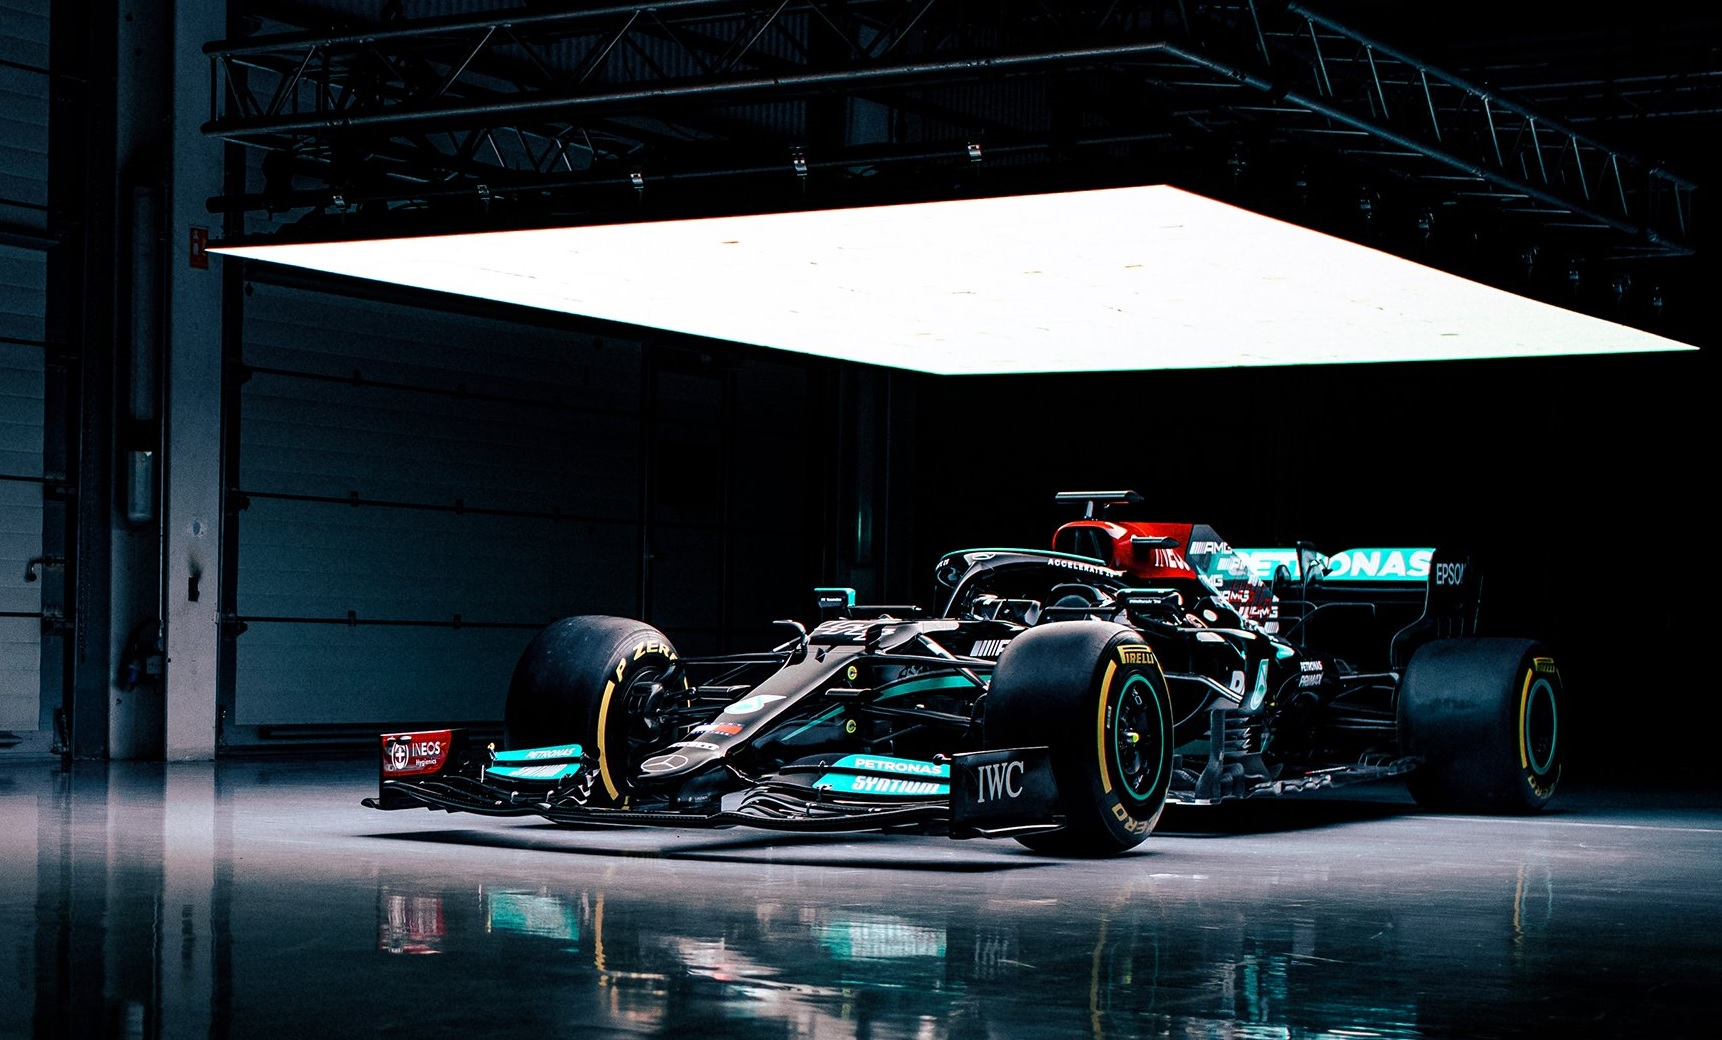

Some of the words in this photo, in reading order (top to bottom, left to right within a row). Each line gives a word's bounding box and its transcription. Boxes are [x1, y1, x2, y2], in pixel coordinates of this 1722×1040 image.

[1047, 558, 1104, 576] ACCELERATE
[1236, 550, 1434, 577] ETONAS
[1436, 562, 1467, 586] EPSO
[1116, 644, 1155, 665] PIRELLI
[615, 657, 627, 683] P
[412, 741, 441, 757] INEOS
[524, 747, 576, 760] PETRONAS
[415, 757, 437, 767] Hygienics
[854, 758, 942, 775] PETRONAS
[977, 760, 1024, 803] IWC
